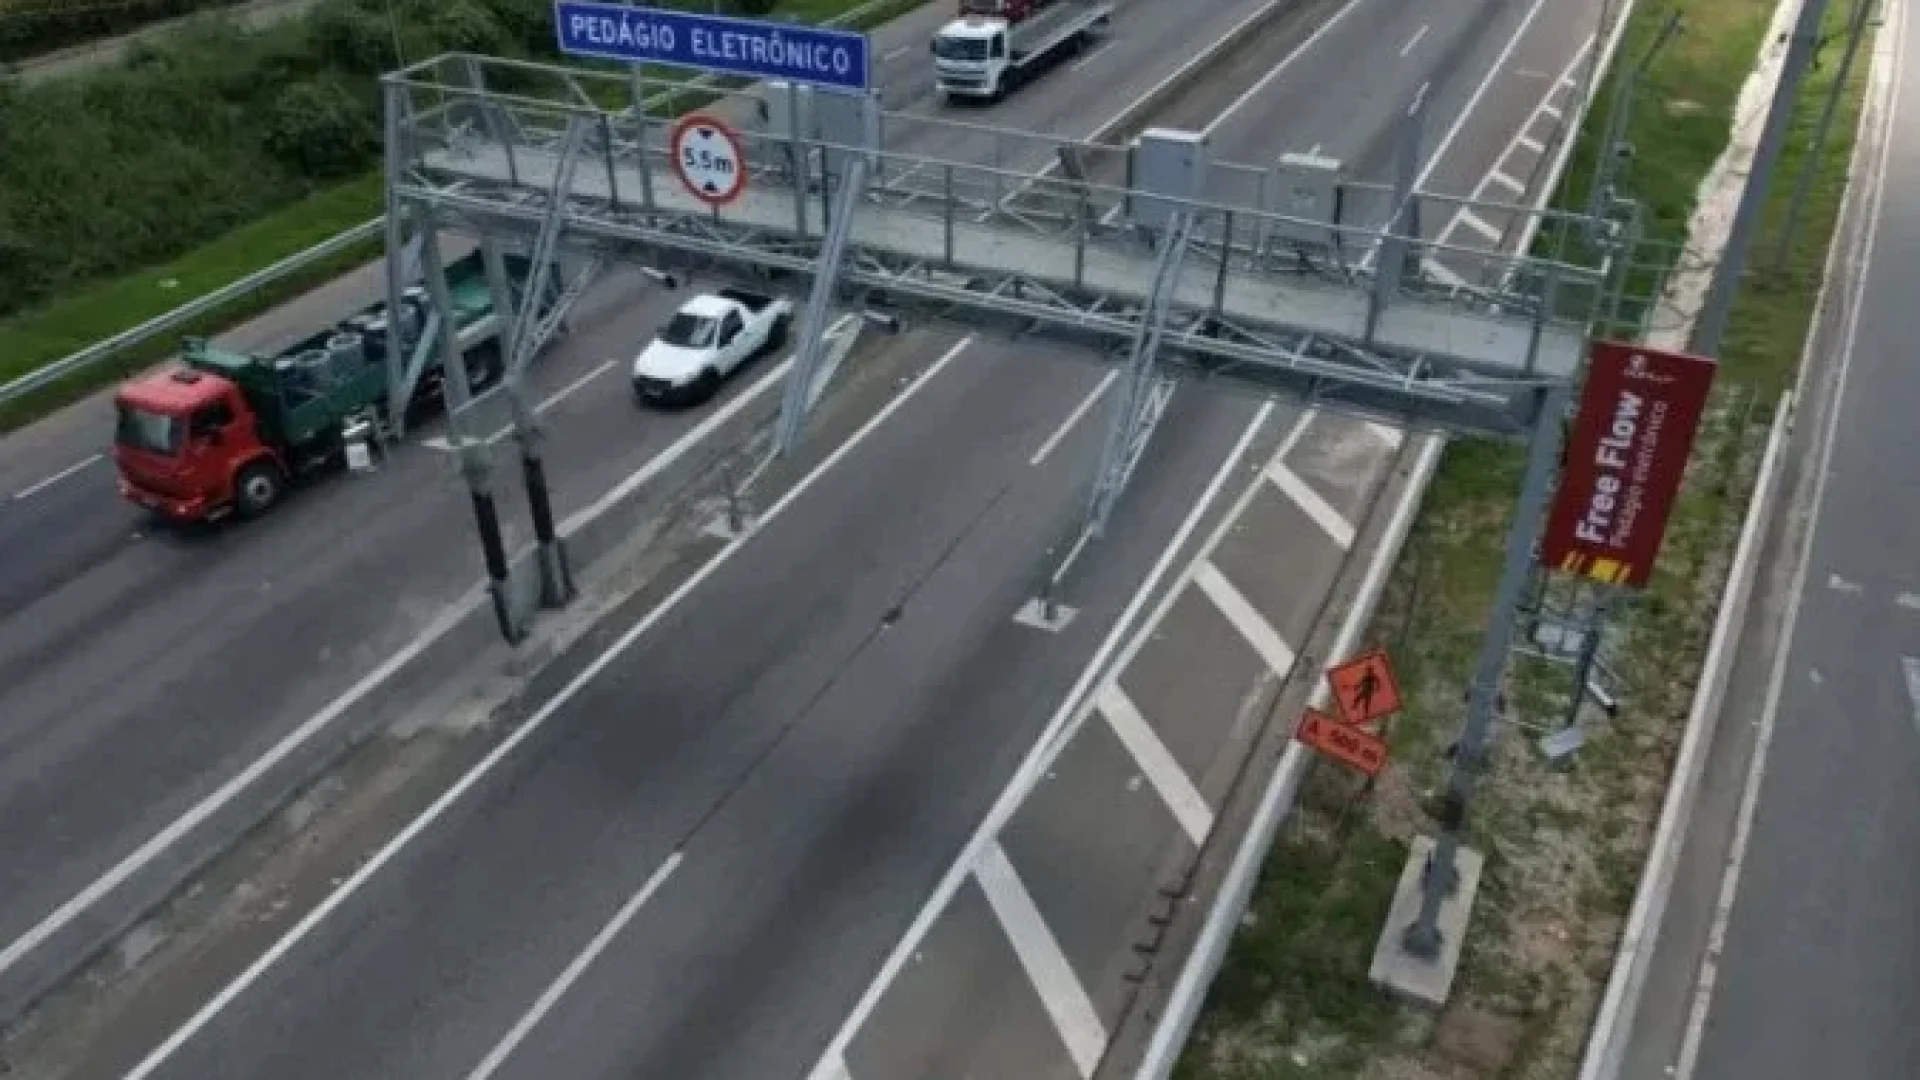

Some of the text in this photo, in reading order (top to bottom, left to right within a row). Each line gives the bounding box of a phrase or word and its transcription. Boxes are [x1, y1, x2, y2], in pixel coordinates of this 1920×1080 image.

[570, 11, 850, 75] PEDÁGIO ELETRÔNICO
[1575, 389, 1644, 543] Free Flow
